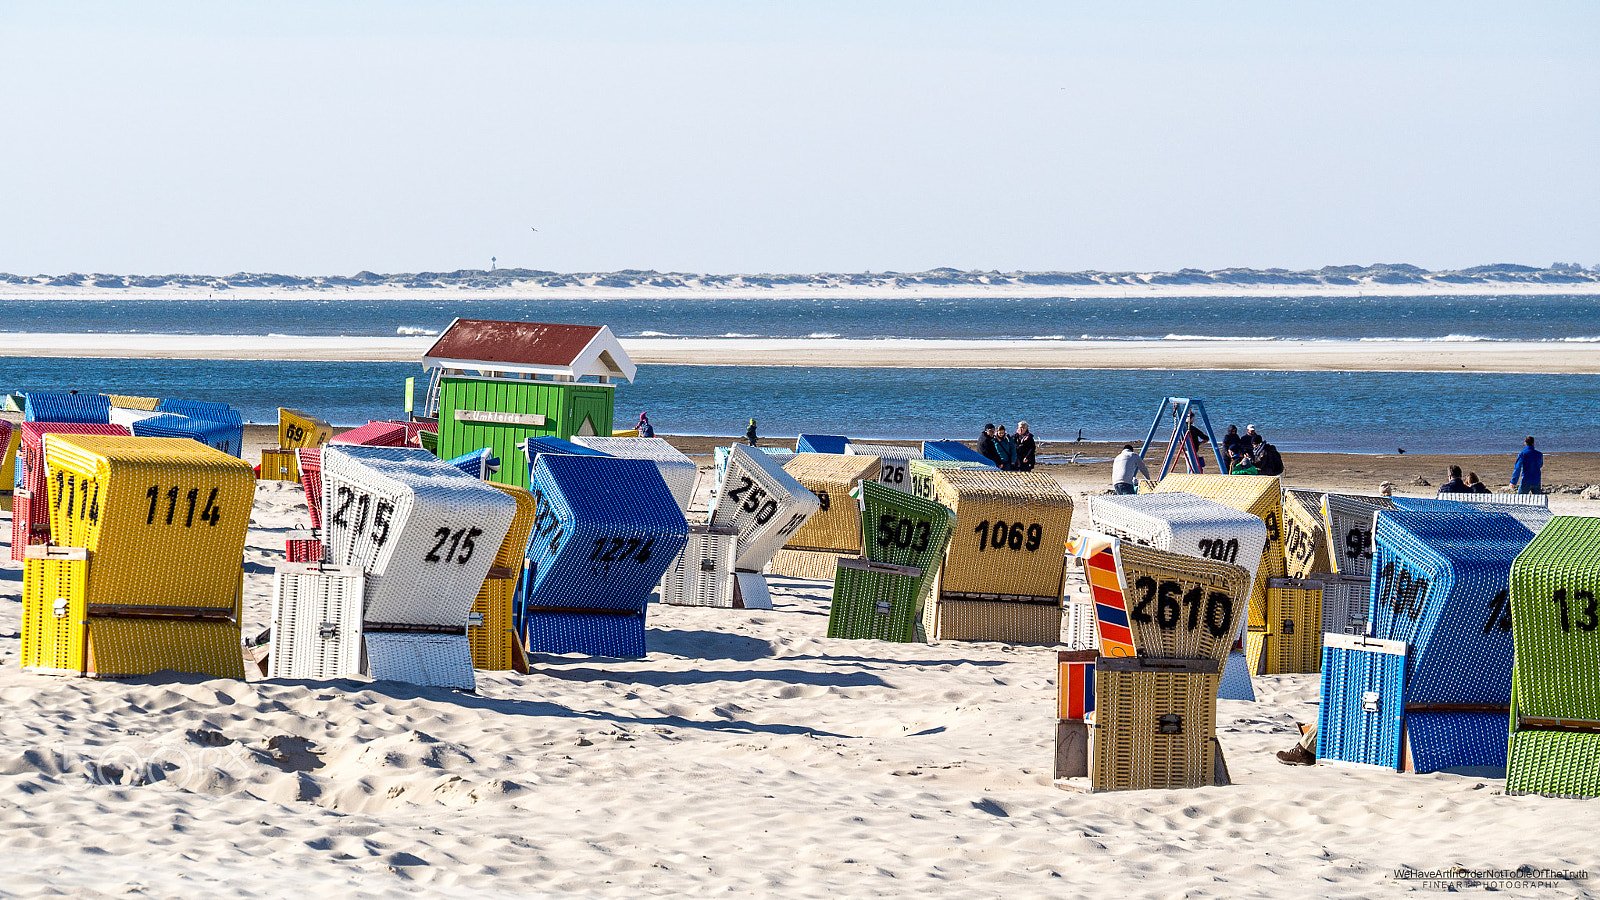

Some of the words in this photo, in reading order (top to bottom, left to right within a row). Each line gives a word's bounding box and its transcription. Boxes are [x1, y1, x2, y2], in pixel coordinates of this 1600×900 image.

[287, 424, 303, 442] 69
[146, 485, 220, 527] 1114
[333, 486, 395, 547] 215
[728, 476, 778, 526] 250
[424, 526, 483, 564] 215
[878, 514, 931, 551] 503
[975, 519, 1043, 552] 1069
[1131, 576, 1234, 638] 2610
[1552, 588, 1598, 632] 13
